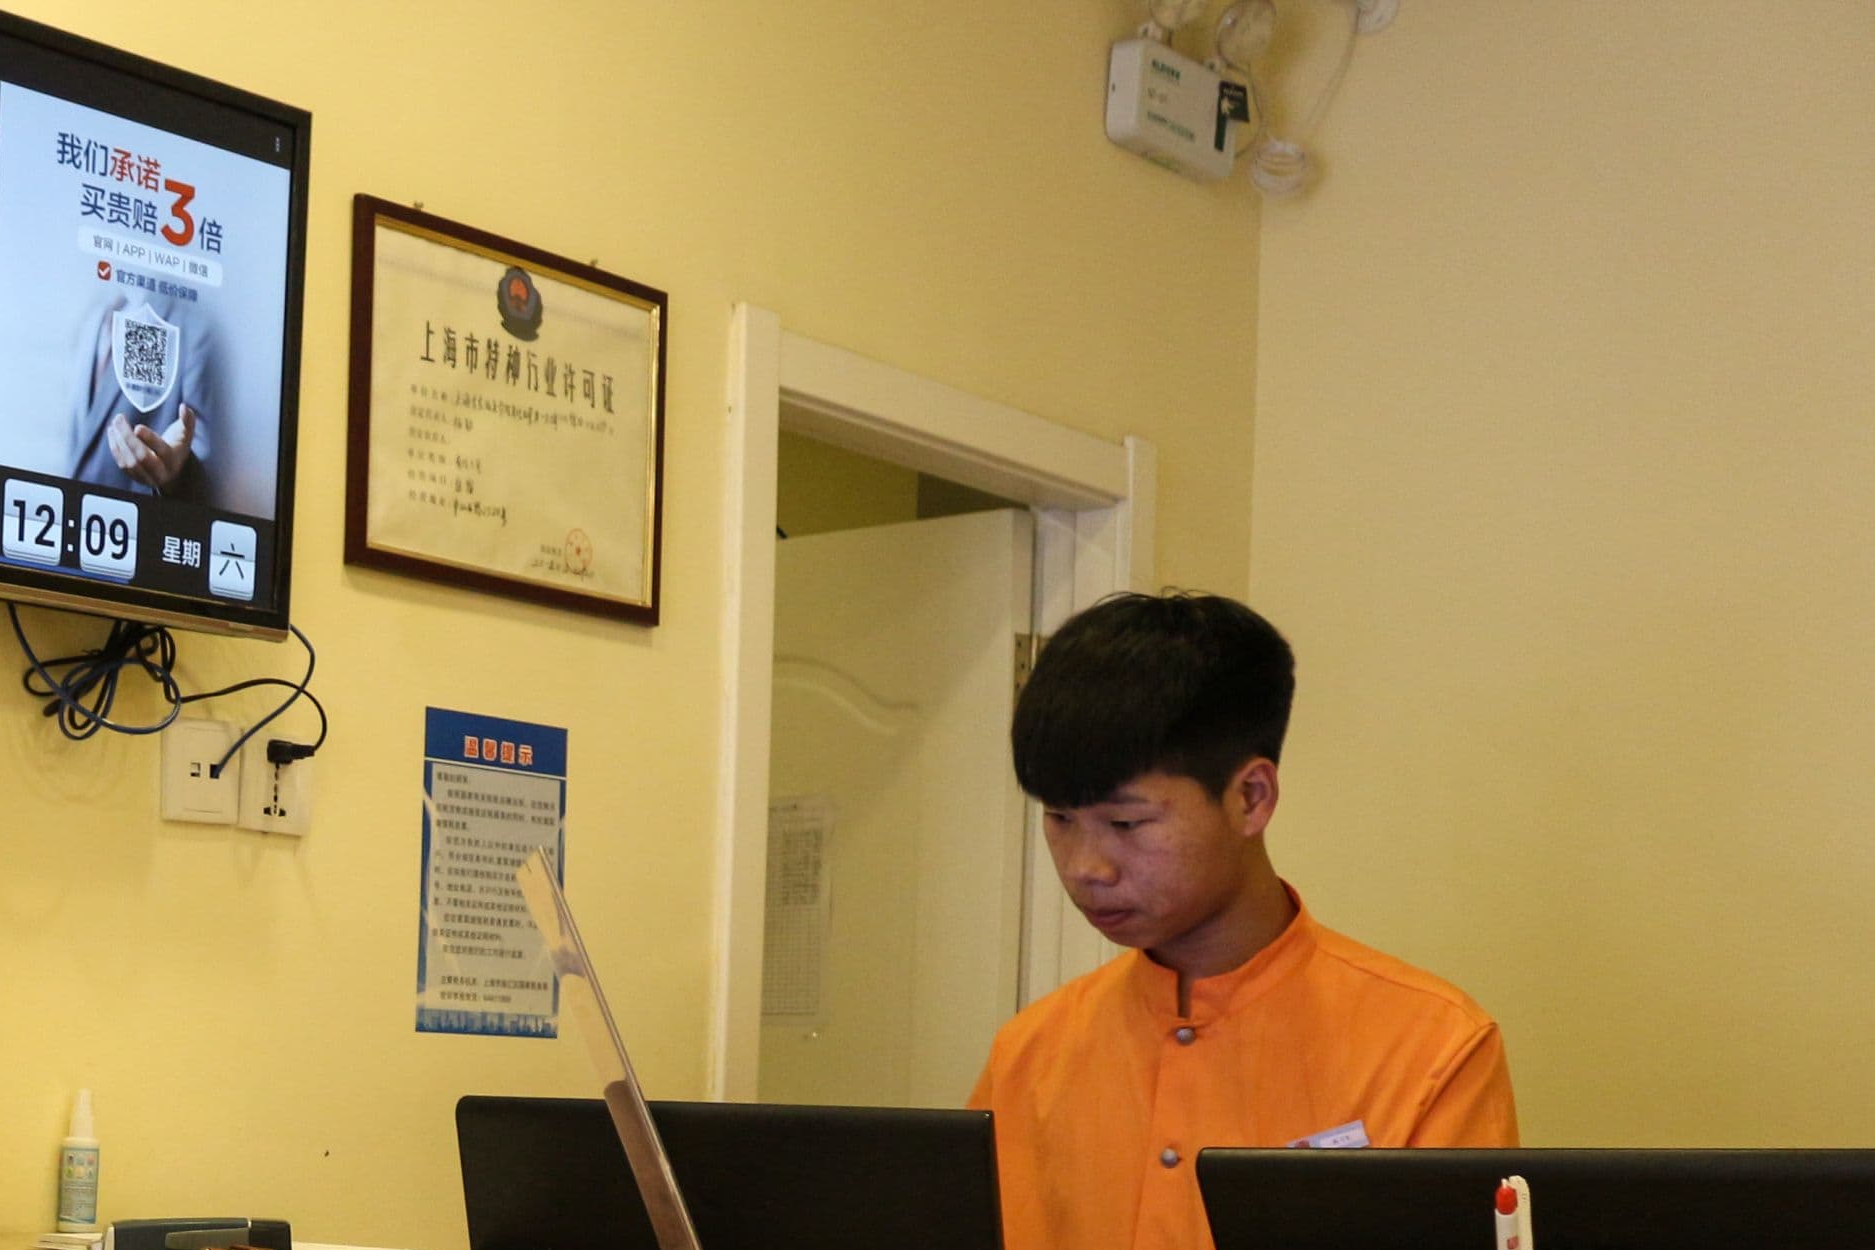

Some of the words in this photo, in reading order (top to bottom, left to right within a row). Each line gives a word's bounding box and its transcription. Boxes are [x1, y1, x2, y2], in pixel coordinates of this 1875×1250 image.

[57, 131, 161, 193] 我们承诺
[122, 244, 146, 262] APP
[155, 252, 180, 270] WAP
[13, 499, 129, 560] 12:09
[162, 535, 201, 568] 星期
[219, 543, 245, 579] 六
